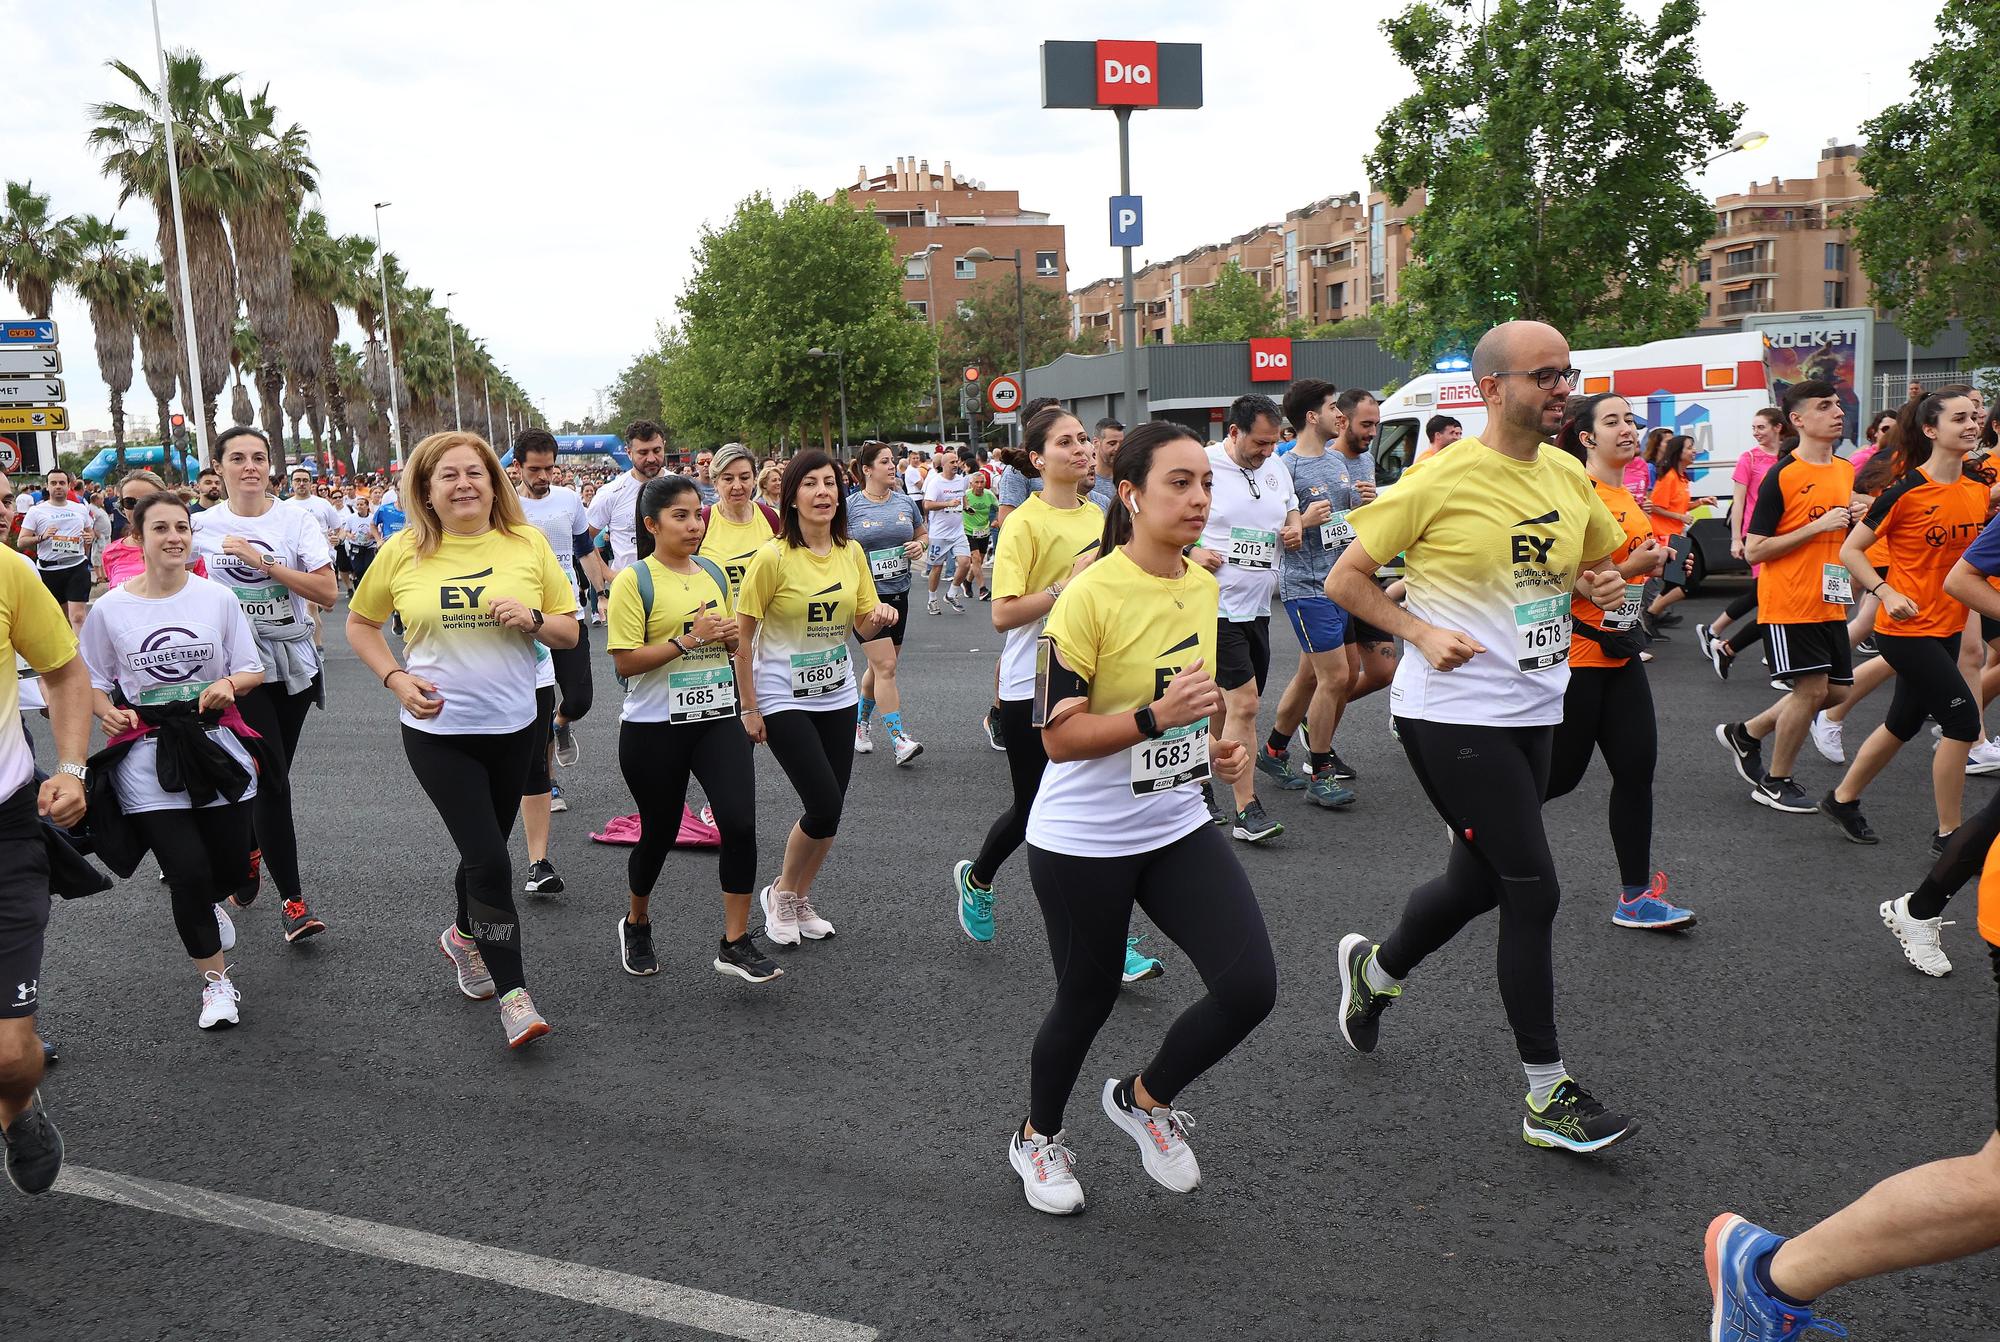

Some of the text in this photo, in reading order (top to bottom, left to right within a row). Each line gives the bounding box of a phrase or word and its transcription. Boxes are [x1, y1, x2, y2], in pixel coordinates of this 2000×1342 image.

[1104, 59, 1151, 84] Dia
[1119, 209, 1137, 233] P
[1255, 351, 1288, 368] Dia
[1325, 525, 1348, 539] 1489
[1233, 542, 1261, 556] 2013
[1511, 535, 1555, 564] EY
[216, 558, 247, 566] COLIS
[876, 560, 898, 571] 1480
[1828, 579, 1839, 591] 896
[441, 586, 486, 609] EY
[442, 613, 476, 621] Building
[807, 601, 839, 622] EY
[443, 621, 476, 629] working
[807, 625, 830, 633] Building
[1525, 624, 1561, 649] 1678
[181, 649, 208, 659] TEAM
[682, 653, 704, 661] working
[798, 667, 833, 683] 1680
[676, 689, 714, 706] 1685
[1141, 742, 1190, 770] 1683
